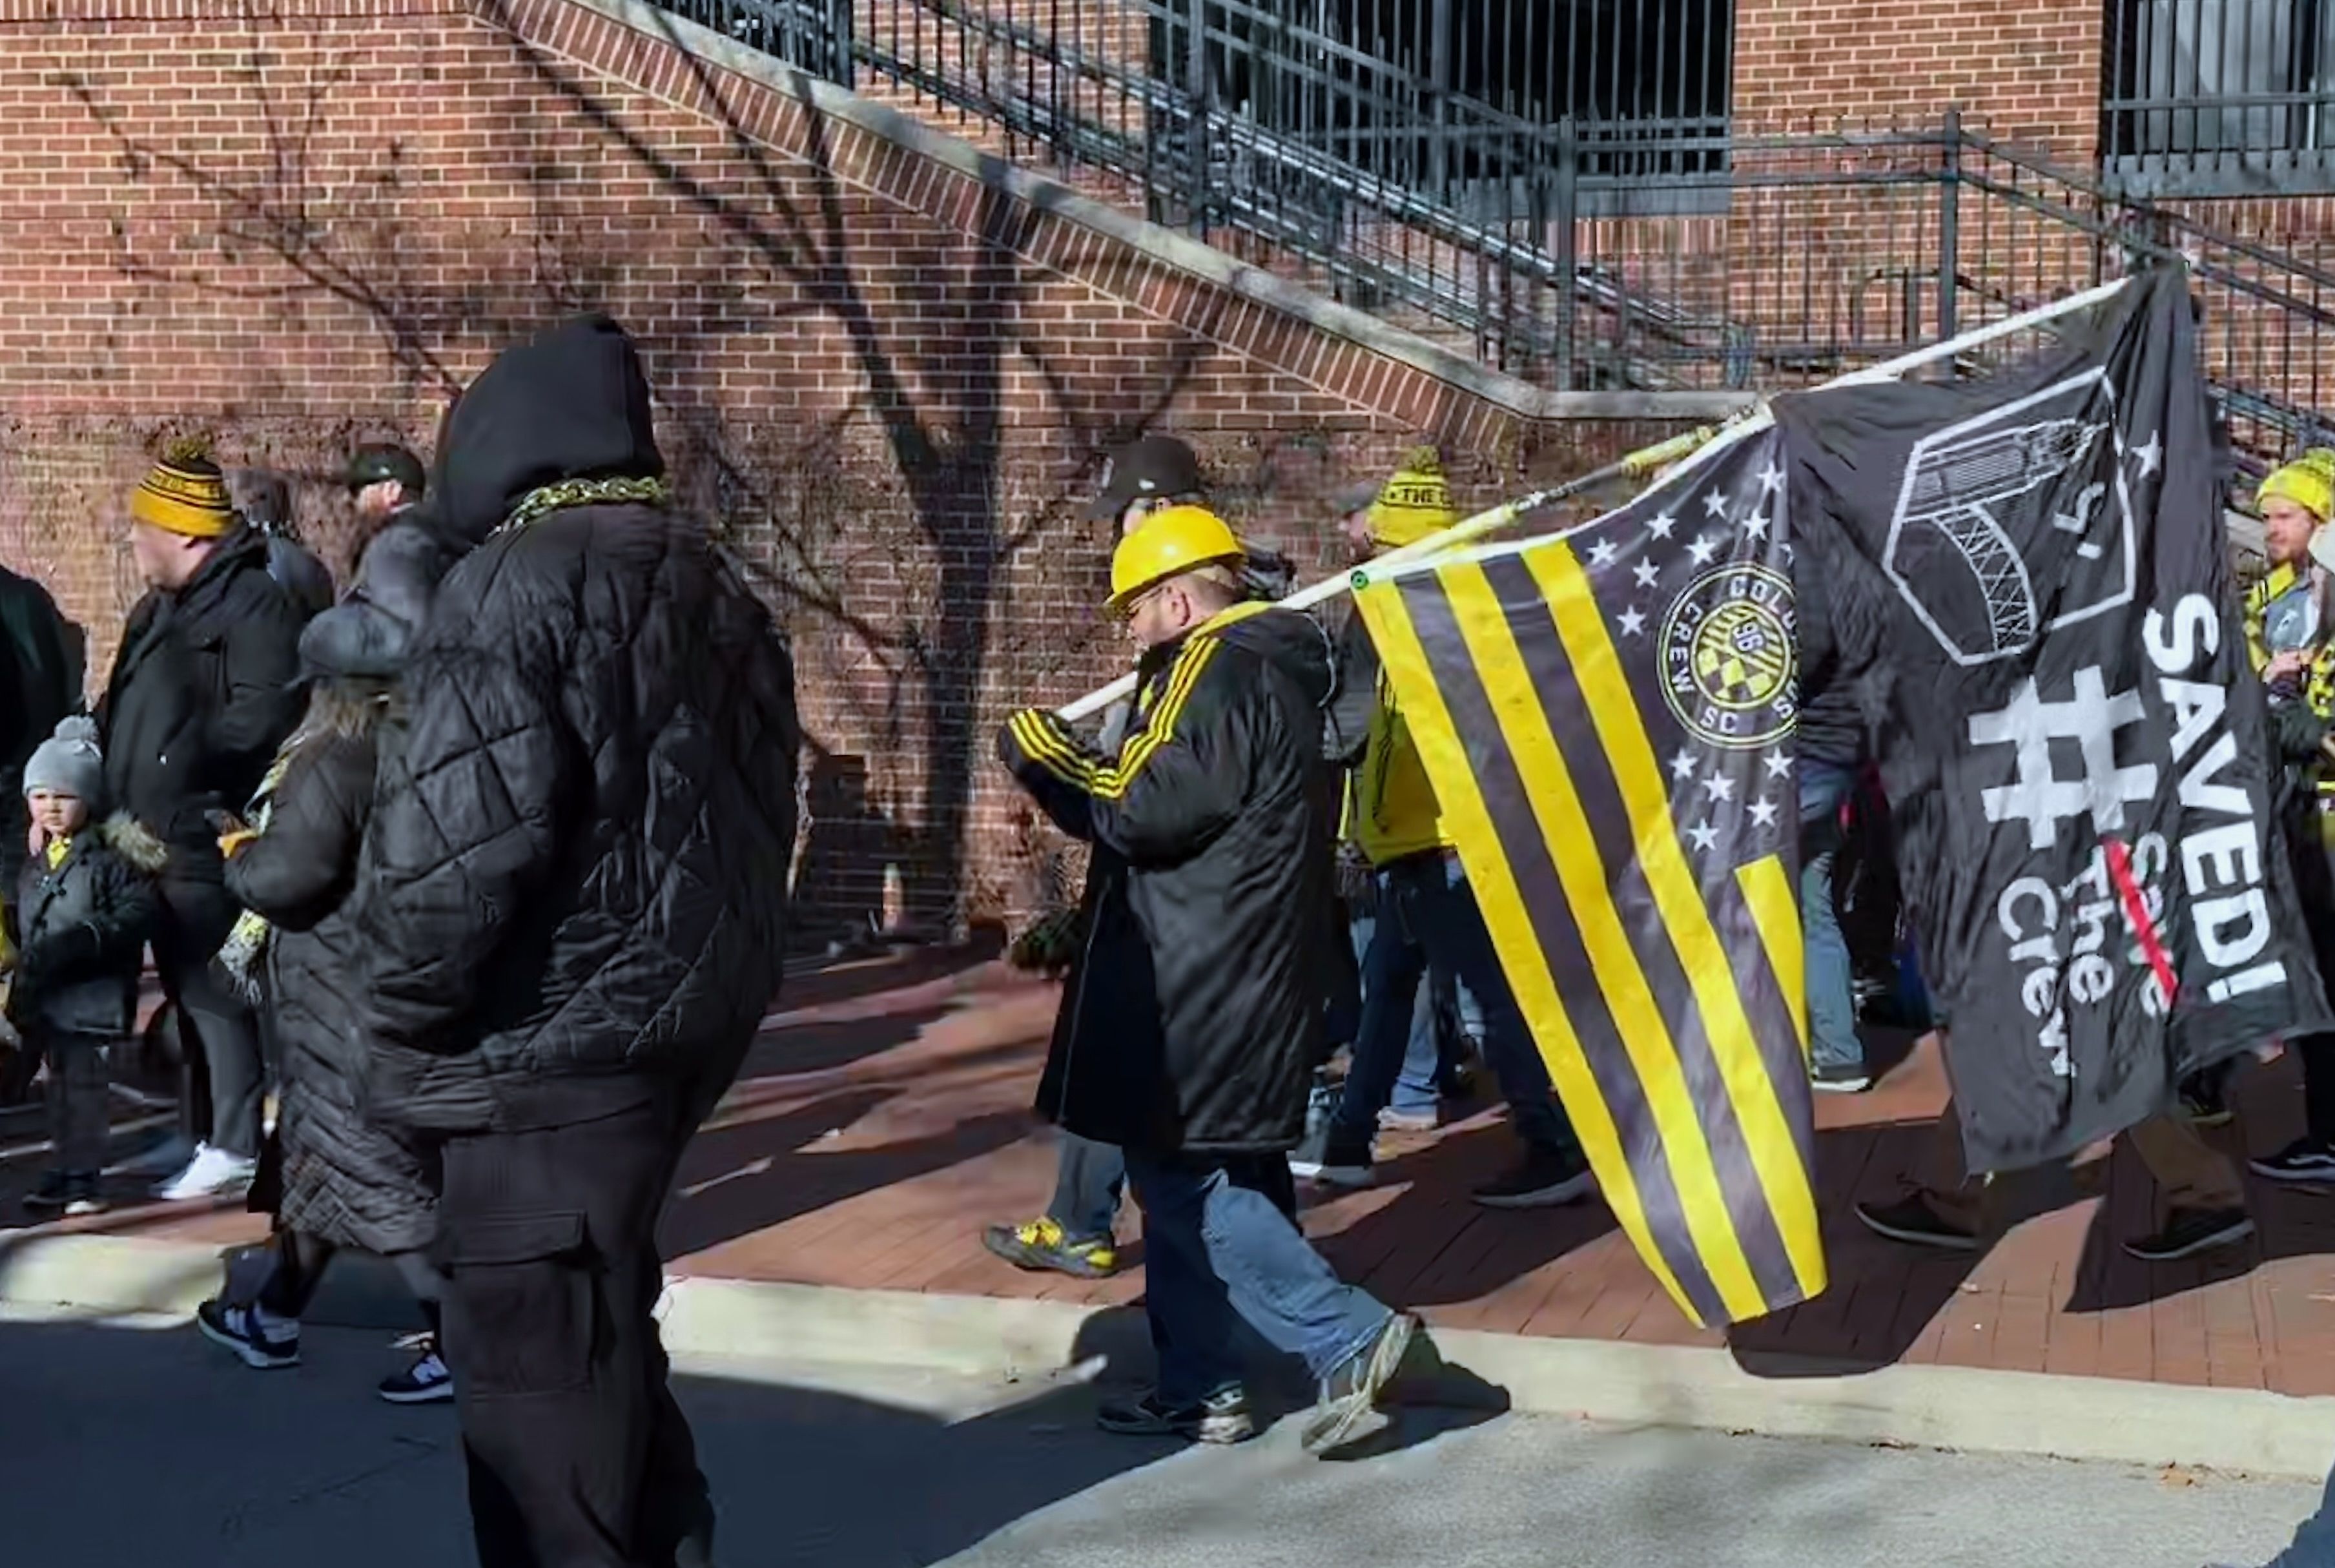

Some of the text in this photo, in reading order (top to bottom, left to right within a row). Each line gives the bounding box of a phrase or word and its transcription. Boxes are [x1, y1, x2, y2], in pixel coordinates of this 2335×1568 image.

[1403, 489, 1434, 503] THE
[1668, 601, 1703, 693] CREW
[1700, 706, 1738, 734] SC
[2143, 593, 2287, 1004] SAVED!
[2061, 845, 2114, 1004] The
